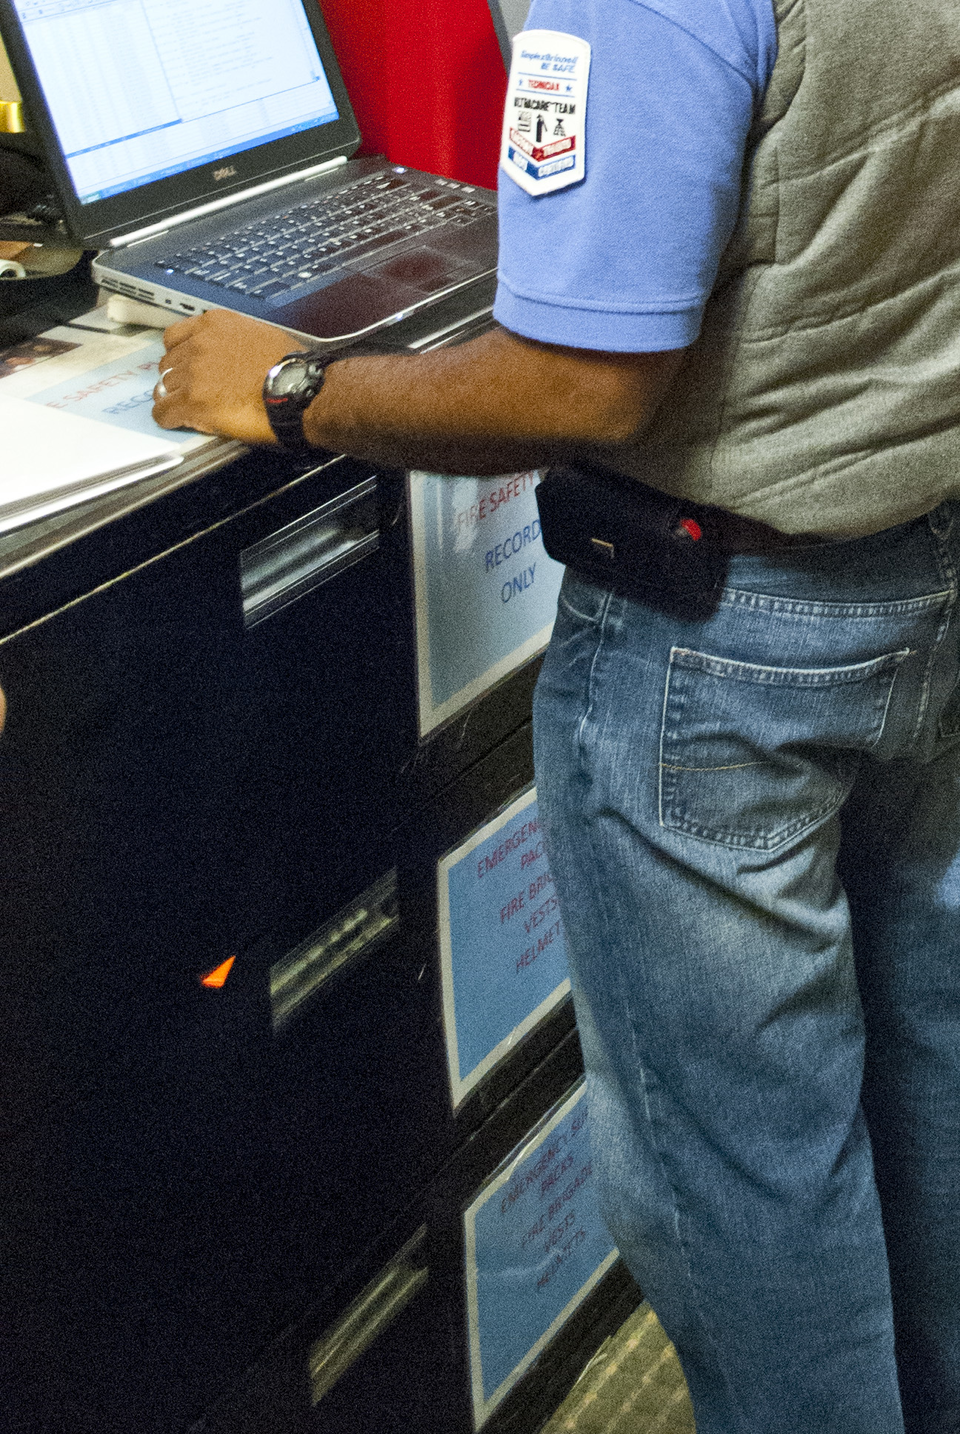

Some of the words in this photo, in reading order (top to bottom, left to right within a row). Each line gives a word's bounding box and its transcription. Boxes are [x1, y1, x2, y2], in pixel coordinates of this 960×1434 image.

[554, 102, 576, 115] TEAM
[63, 370, 138, 402] SAFETY
[457, 498, 486, 527] FIRE
[489, 470, 534, 513] SAFETY
[501, 562, 537, 604] ONLY
[477, 819, 541, 879] EMERGEN
[500, 891, 525, 925] FIRE
[516, 919, 561, 975] HELMET
